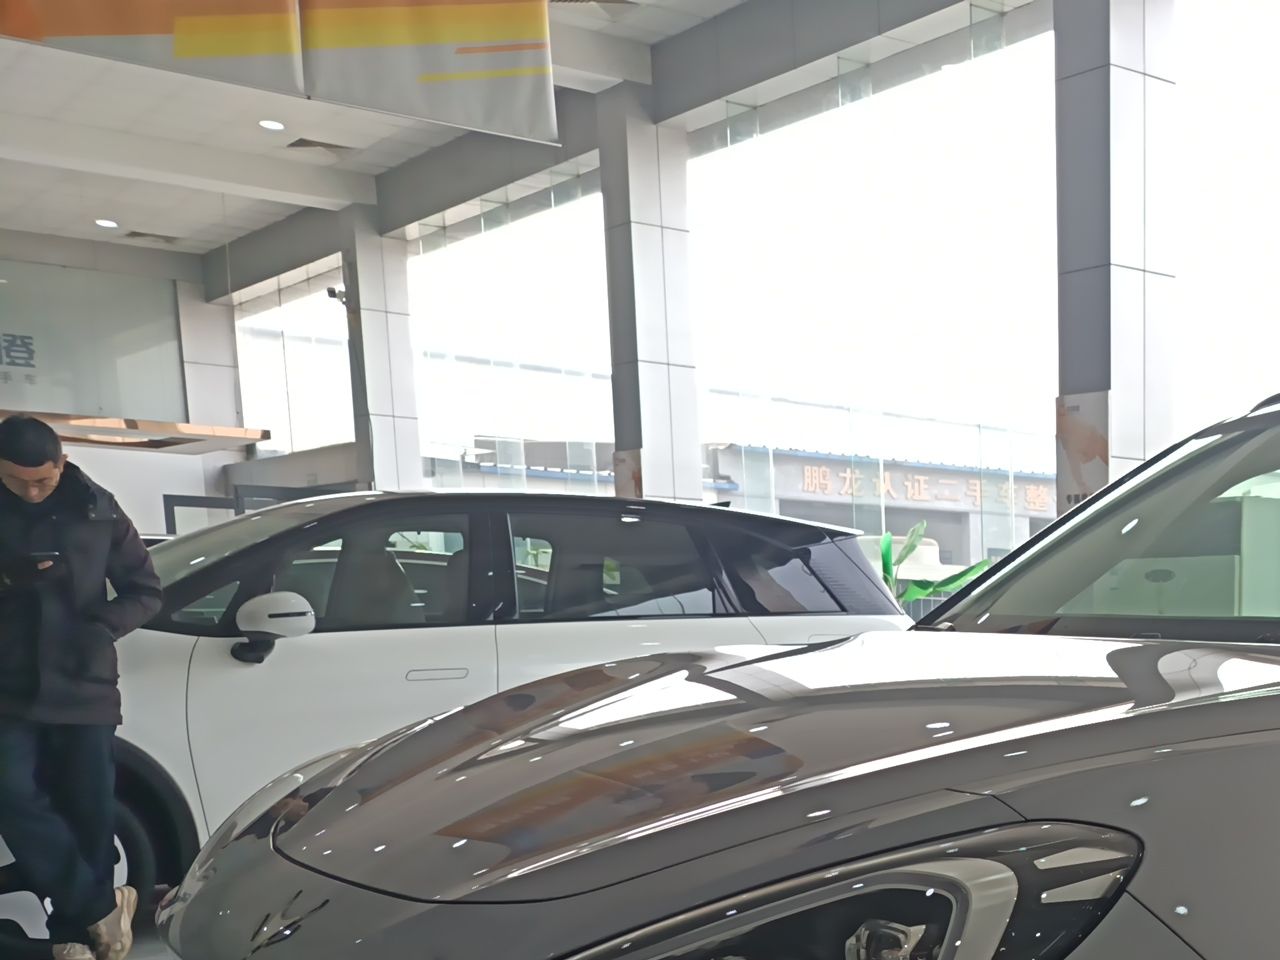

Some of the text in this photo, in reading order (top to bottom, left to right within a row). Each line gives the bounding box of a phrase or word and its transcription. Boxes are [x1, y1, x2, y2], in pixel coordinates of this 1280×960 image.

[802, 465, 1057, 512] 鹏龙认证二手车整
